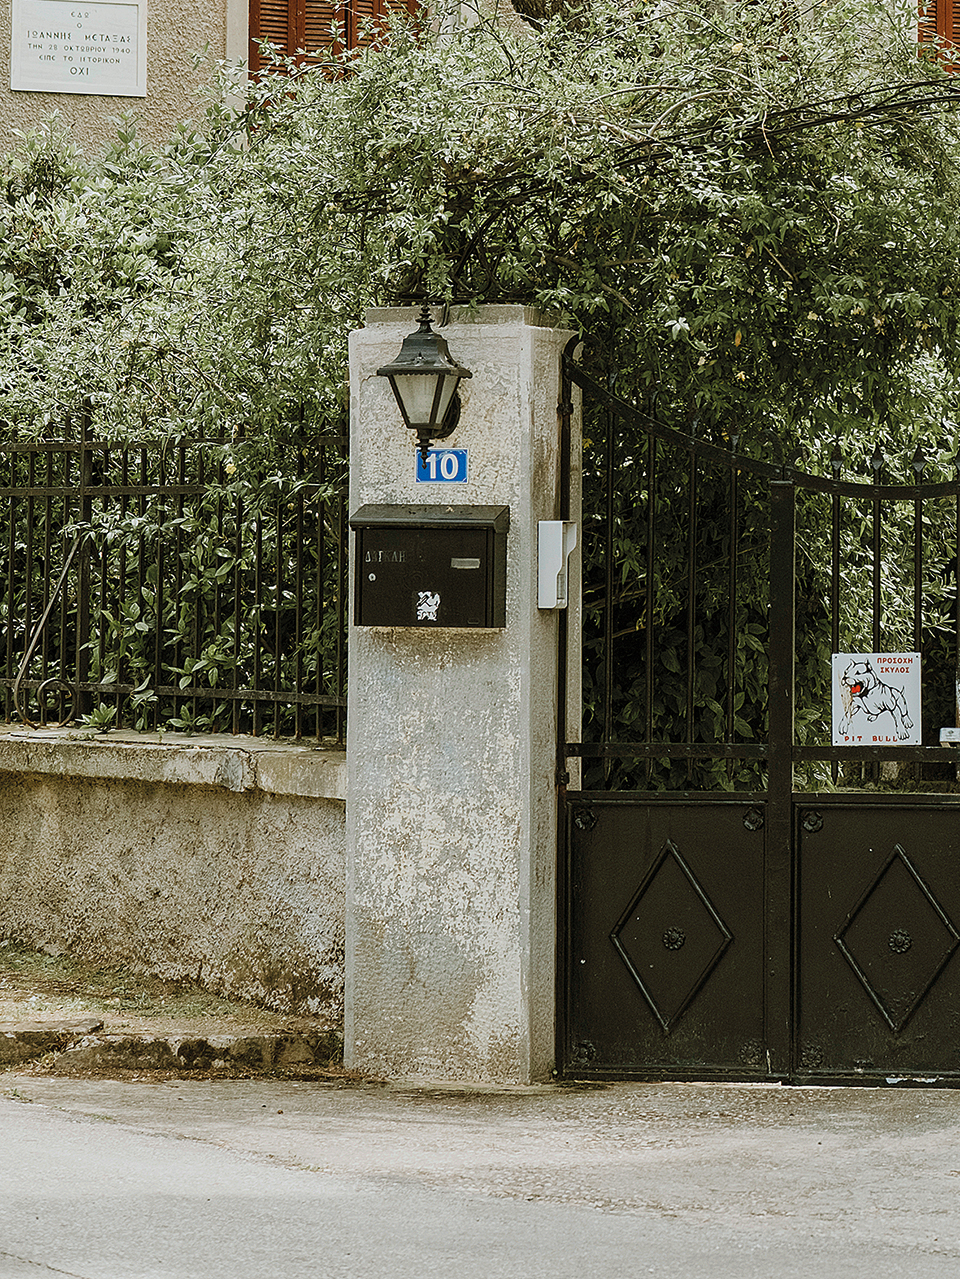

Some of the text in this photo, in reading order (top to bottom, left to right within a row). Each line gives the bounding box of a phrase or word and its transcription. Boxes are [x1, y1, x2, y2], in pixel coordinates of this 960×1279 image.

[70, 11, 90, 19] ΕΔΩ
[27, 30, 131, 43] ΙΩΑΝΝΗΣ ΜΕΤΑΞΑΣ
[38, 54, 56, 62] ΕΙΠΕ
[79, 56, 121, 64] ΙΣΤΟΡΙΚΟΝ
[69, 66, 90, 76] ΟΧΙ
[425, 452, 459, 480] 10
[880, 666, 910, 674] ΣΚΥΛΟΣ
